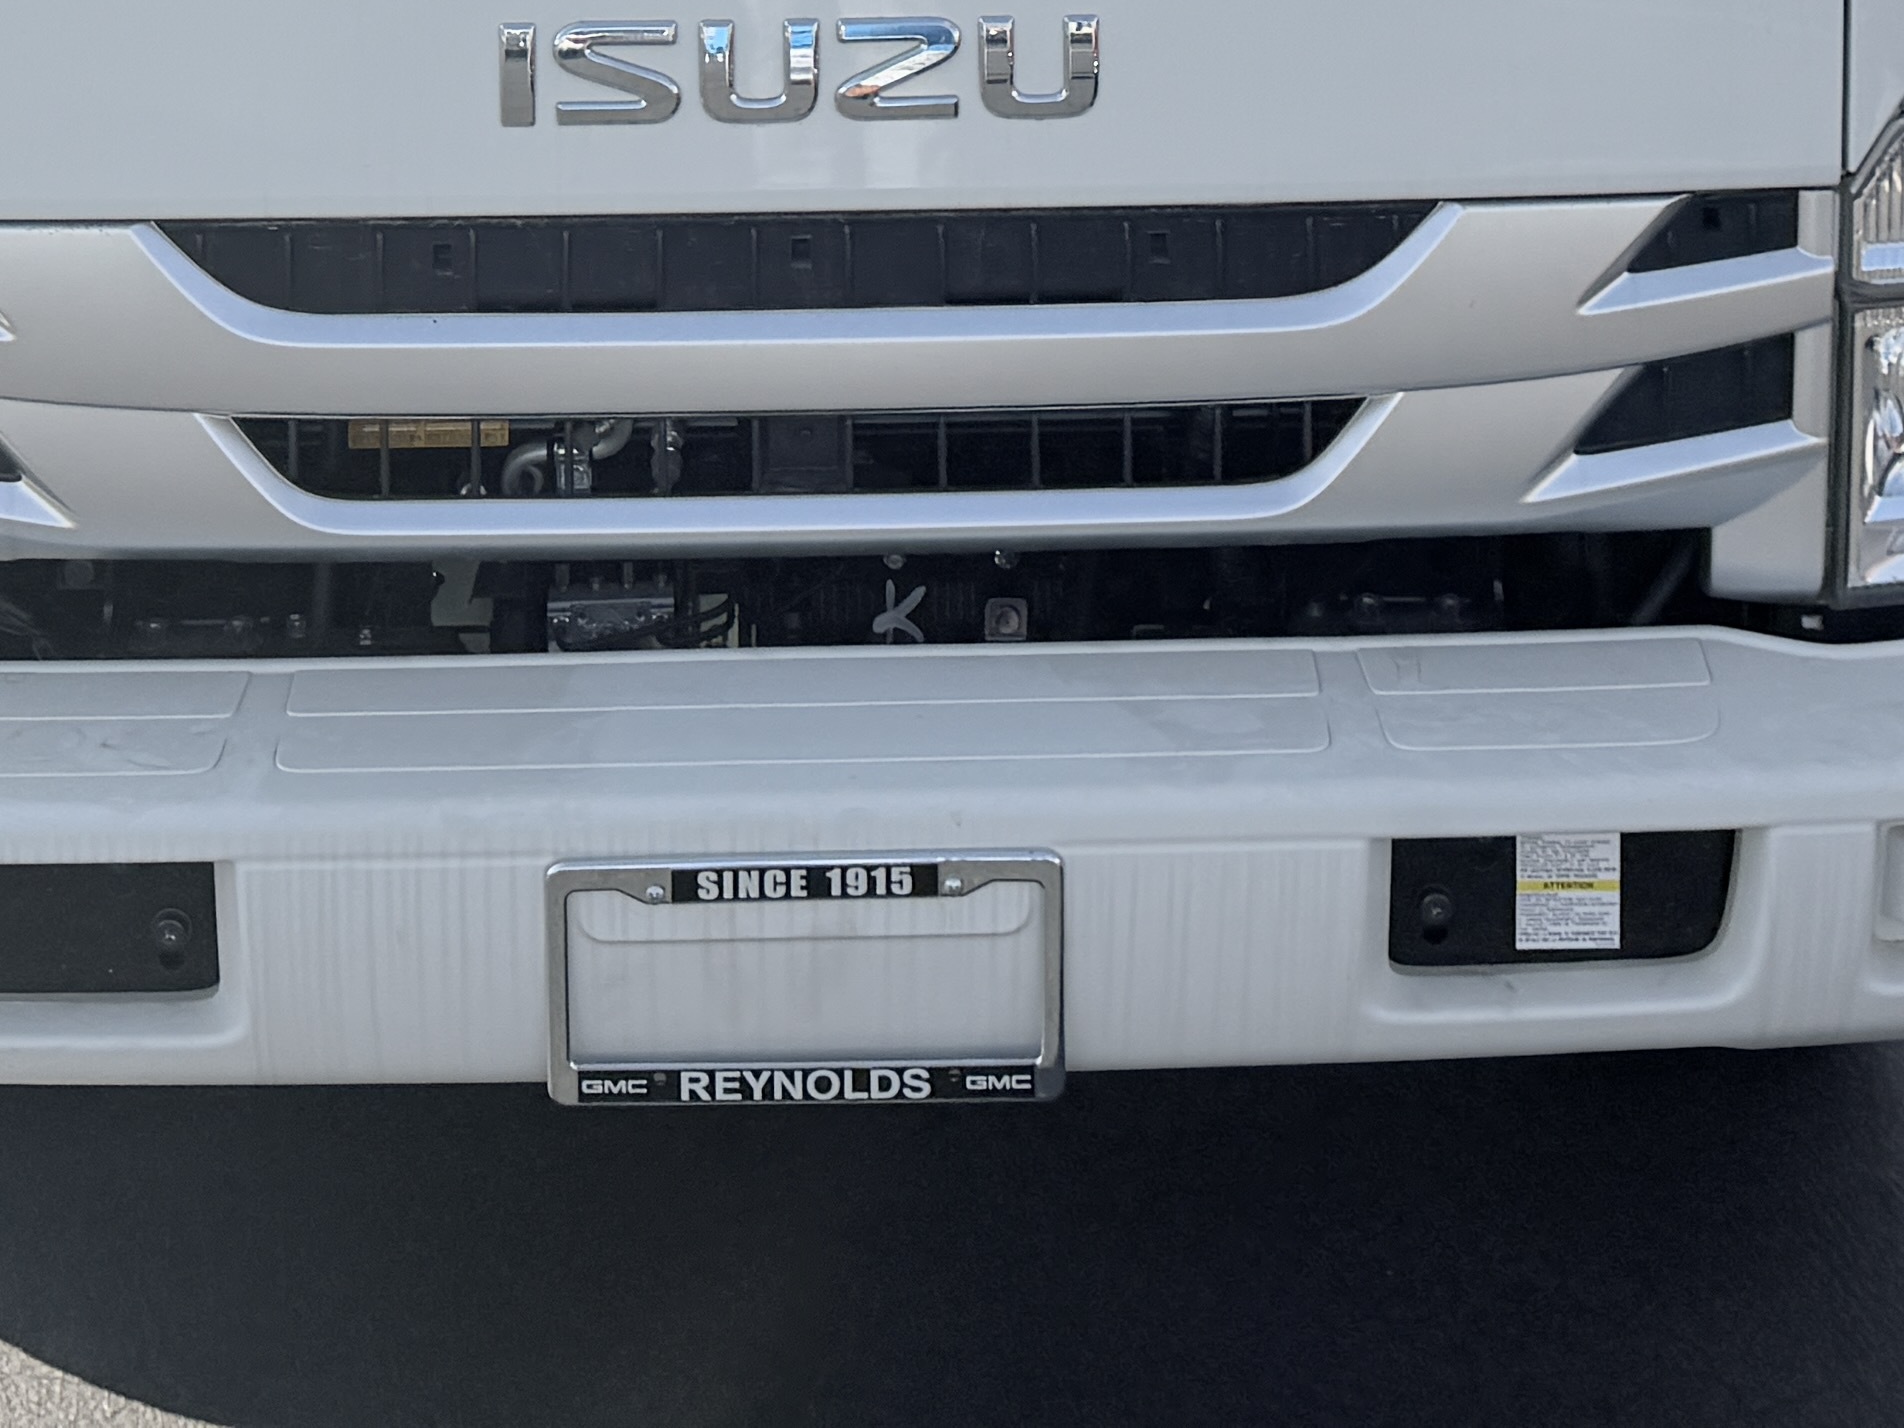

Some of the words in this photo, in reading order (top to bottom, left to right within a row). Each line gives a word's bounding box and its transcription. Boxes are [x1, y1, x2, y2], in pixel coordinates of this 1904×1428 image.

[499, 14, 1100, 126] ISUZU
[697, 868, 809, 899] SINCE
[825, 865, 914, 897] 1915
[580, 1078, 649, 1095] GMC
[680, 1067, 932, 1102] REYNOLDS
[965, 1074, 1033, 1092] GMC
